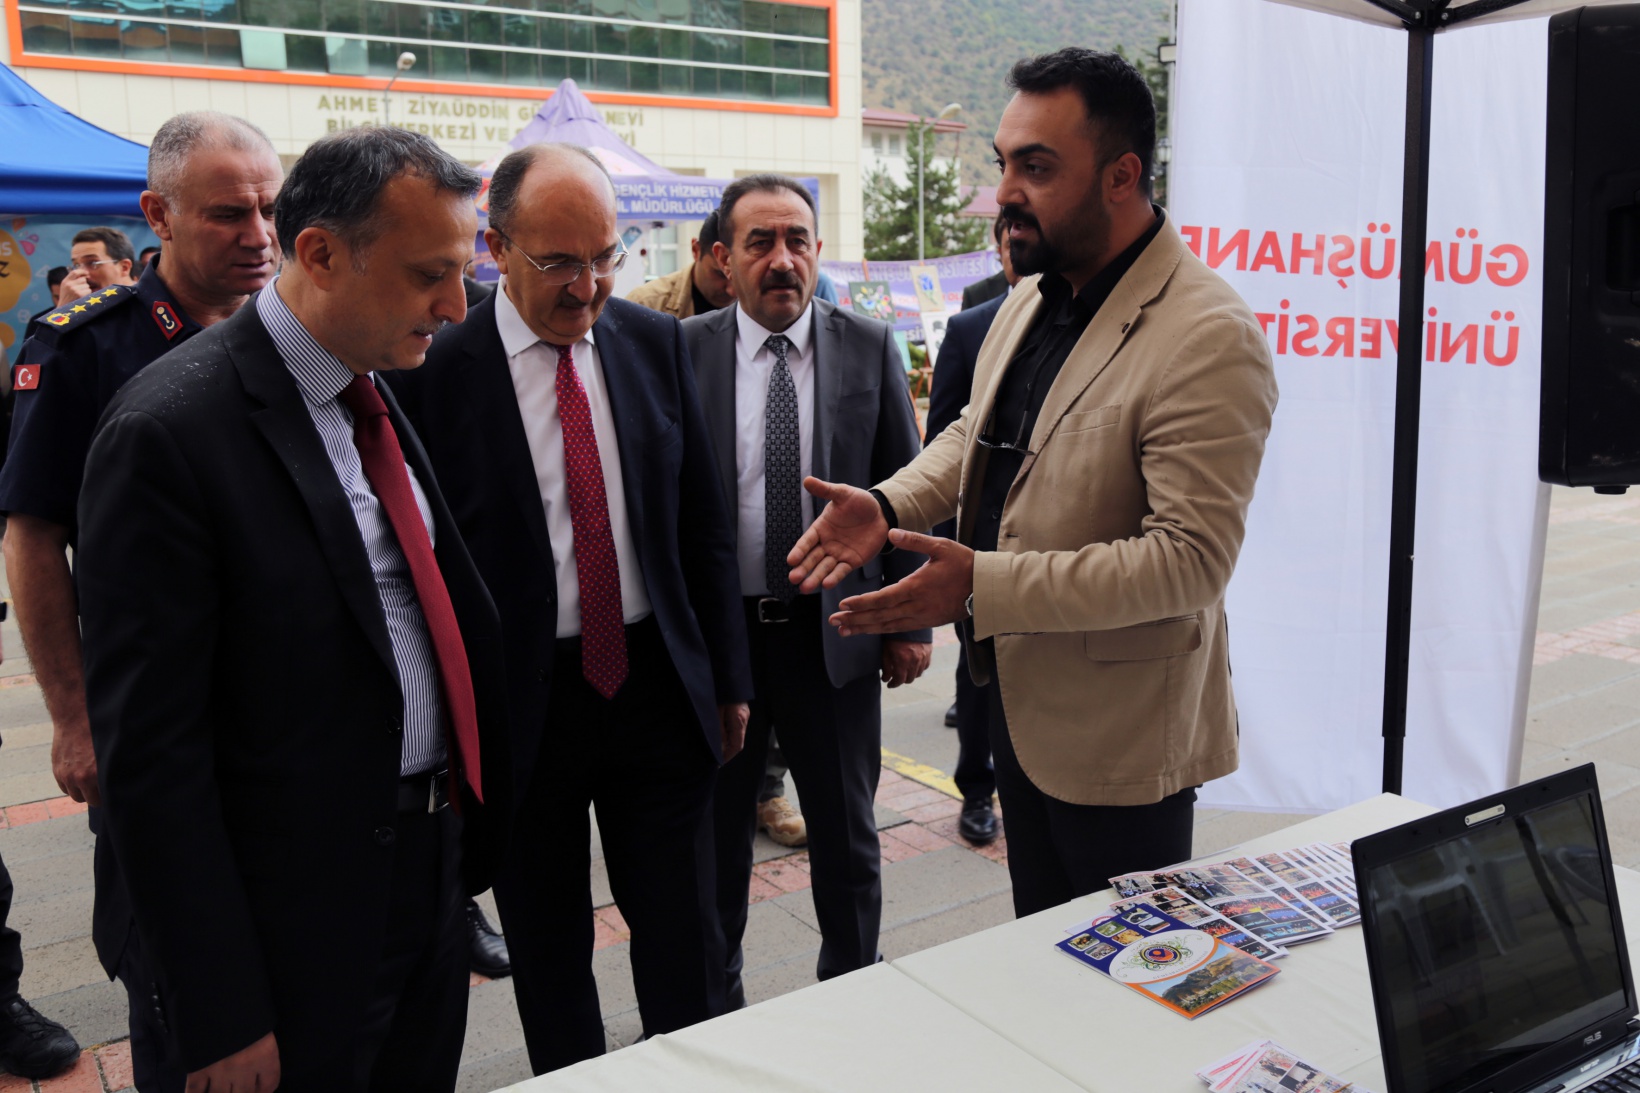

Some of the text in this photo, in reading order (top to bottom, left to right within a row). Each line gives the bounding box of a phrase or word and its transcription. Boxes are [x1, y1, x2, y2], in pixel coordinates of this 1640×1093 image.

[408, 96, 508, 120] ZİYAÜDDİN
[484, 126, 508, 142] VE
[631, 198, 714, 214] MÜDÜRLÜĞÜ
